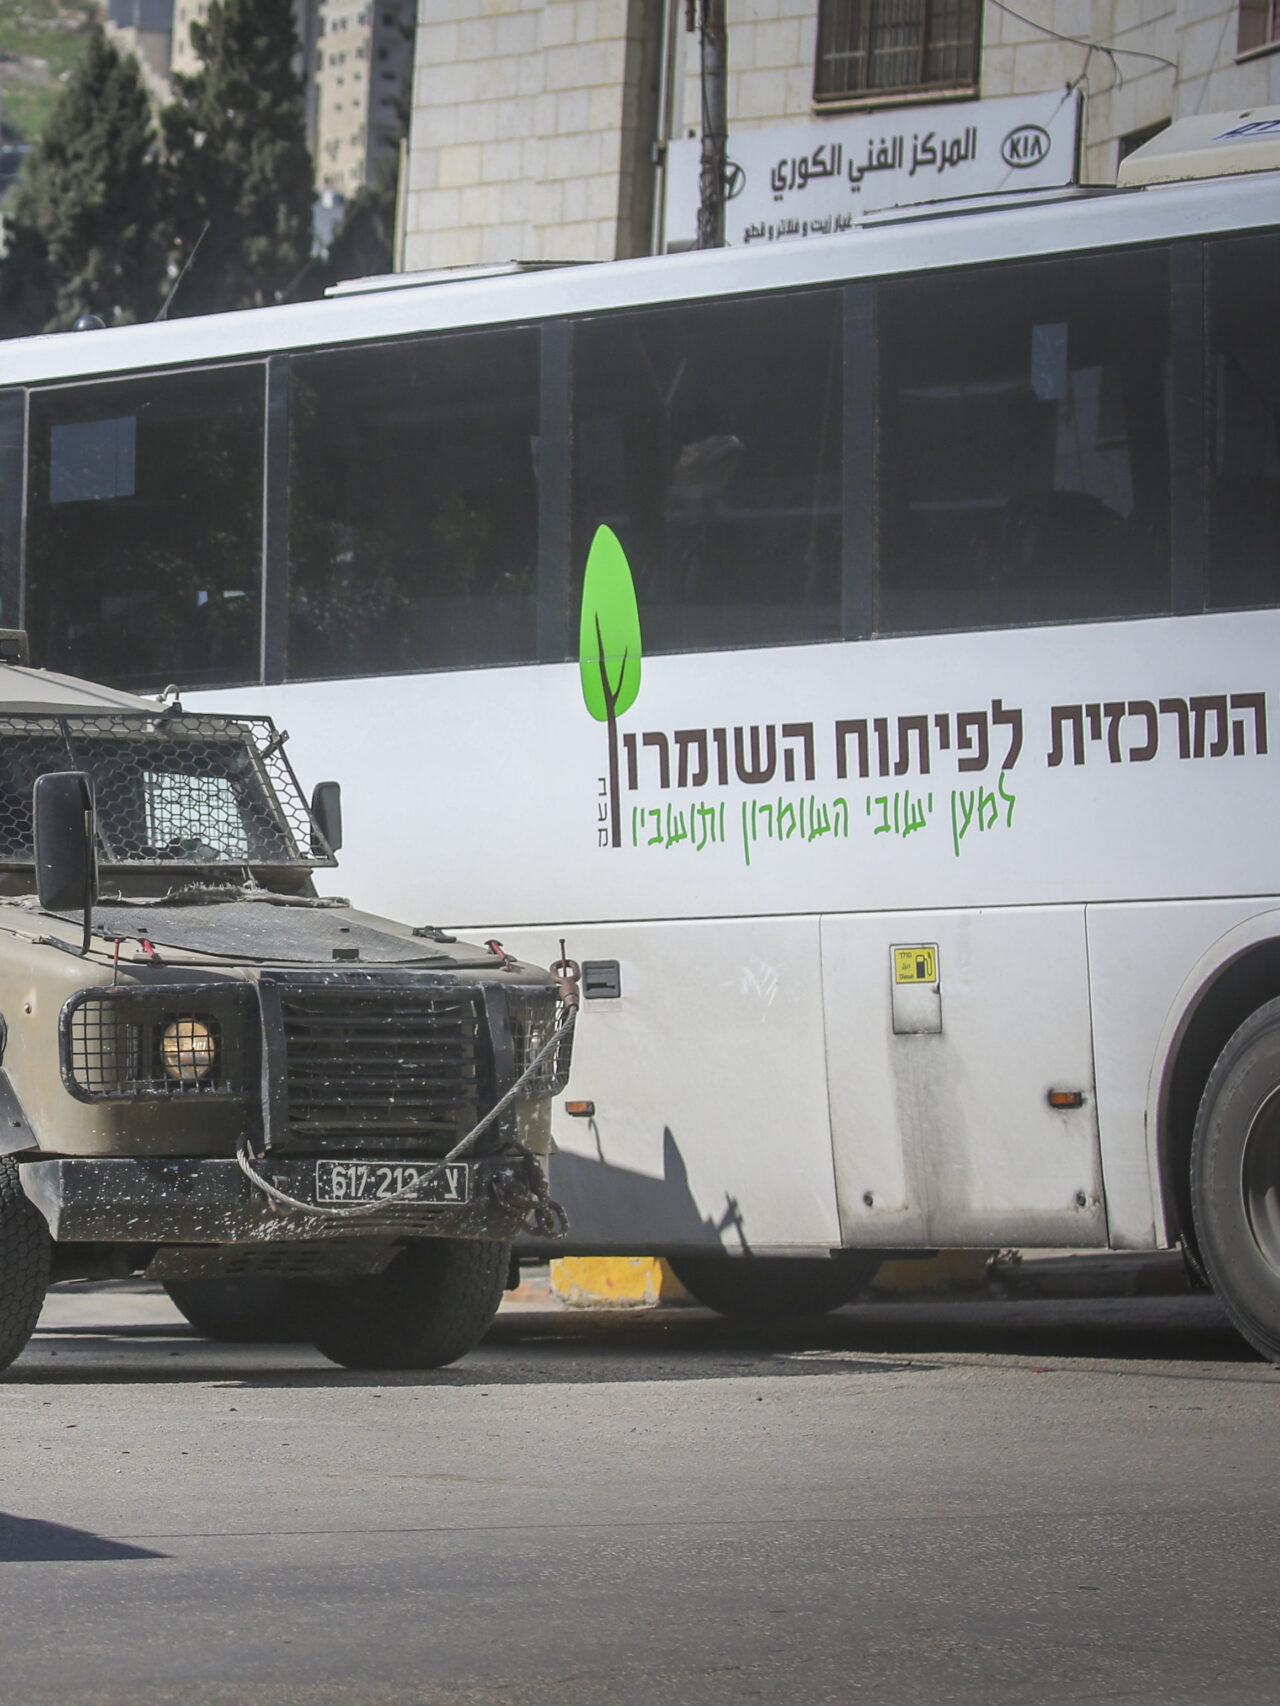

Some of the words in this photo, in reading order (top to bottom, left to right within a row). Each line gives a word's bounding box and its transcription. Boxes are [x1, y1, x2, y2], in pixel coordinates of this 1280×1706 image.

[770, 142, 843, 201] الكوري
[848, 135, 904, 193] الفني
[908, 126, 978, 177] المركز
[1009, 134, 1043, 160] KIA
[834, 698, 1023, 779] לפיתוח
[1047, 691, 1269, 767] המרכזית
[742, 794, 849, 866] השומרון
[866, 789, 933, 838] ישובי
[951, 771, 1016, 857] למען
[332, 1165, 369, 1198] 617
